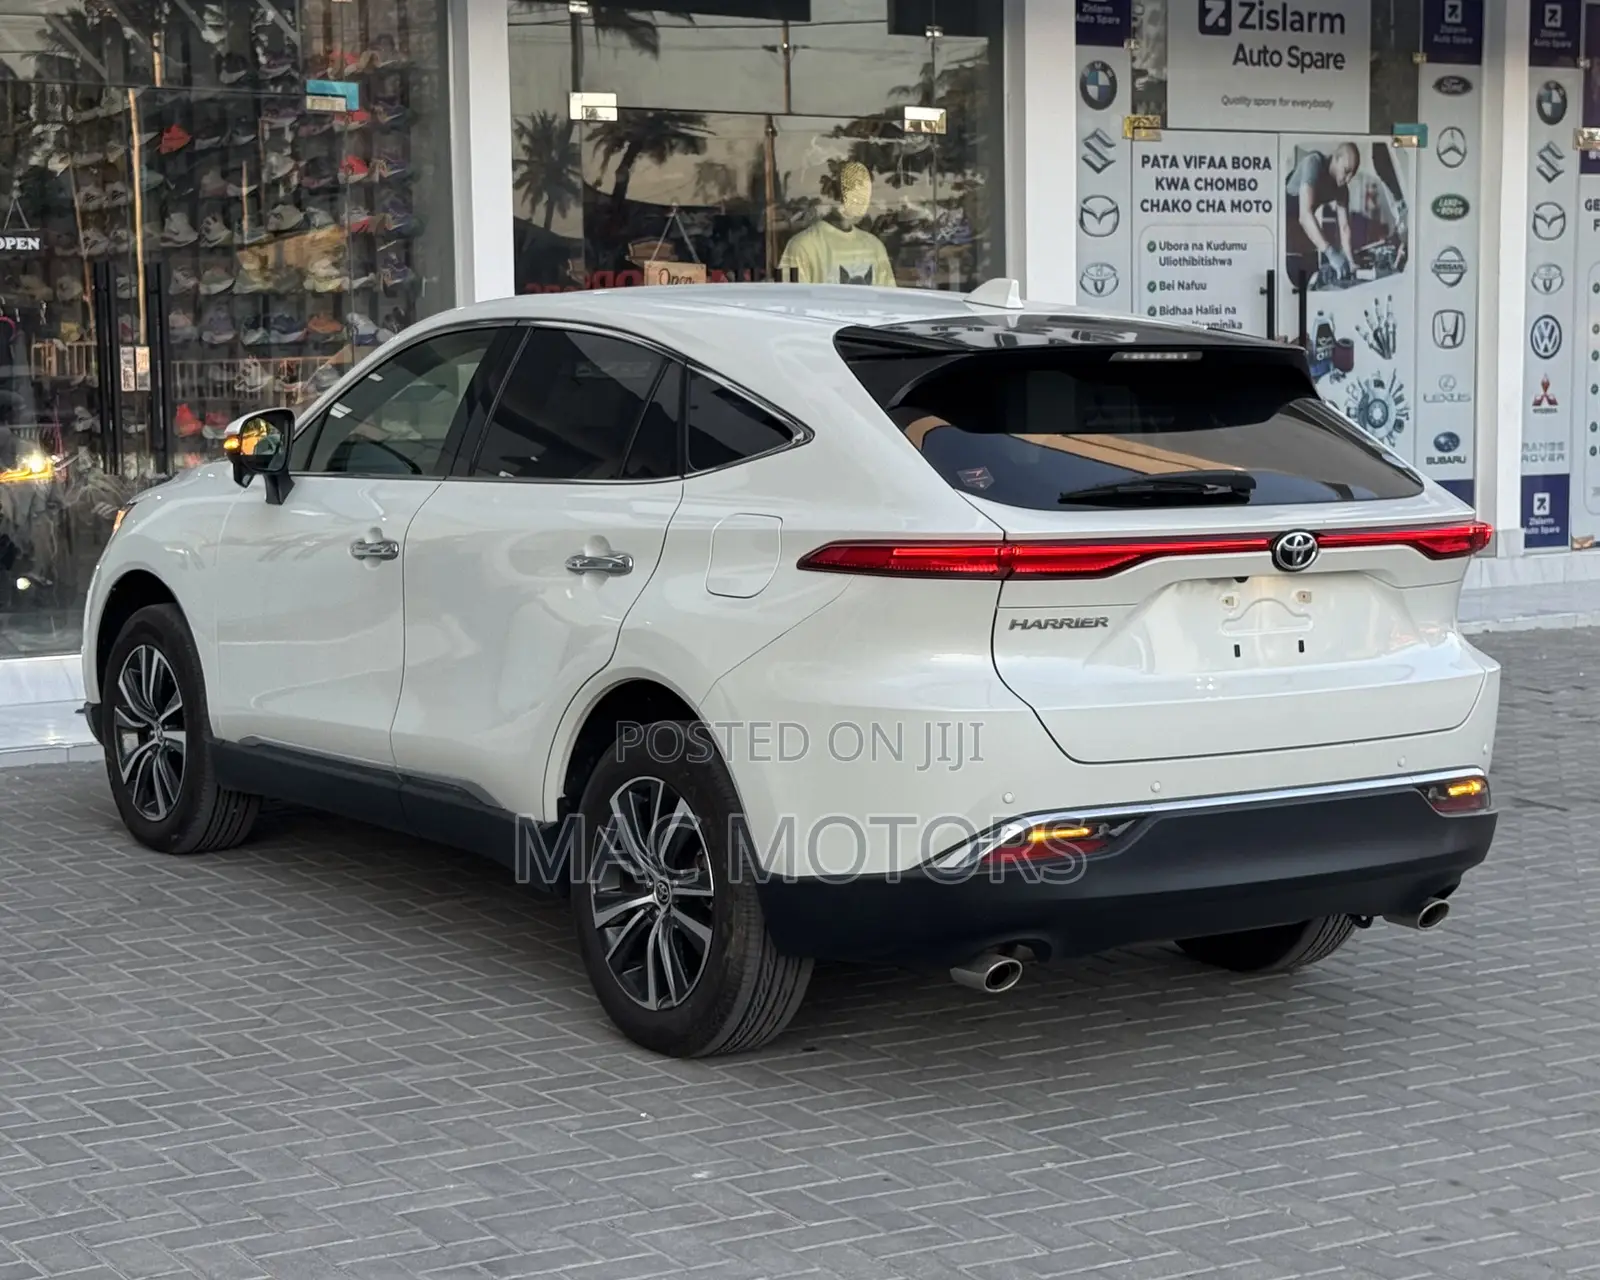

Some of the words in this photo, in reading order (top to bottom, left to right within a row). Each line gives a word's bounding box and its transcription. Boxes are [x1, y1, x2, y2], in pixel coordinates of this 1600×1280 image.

[1238, 0, 1346, 35] Zislarm
[1232, 42, 1283, 68] Auto
[1287, 45, 1346, 74] Spare
[1141, 154, 1179, 169] PATA
[1183, 155, 1228, 170] VIFAA
[1231, 156, 1272, 171] BORA
[1155, 177, 1190, 191] KWA
[1194, 178, 1258, 191] CHOMBO
[1140, 199, 1192, 213] CHAKO
[1196, 199, 1227, 213] CHA
[1230, 200, 1273, 213] MOTO
[1159, 241, 1189, 251] Ubora
[1192, 243, 1204, 251] na
[1159, 257, 1233, 267] Uliothibitishwa
[1159, 280, 1175, 291] Bei
[1177, 280, 1207, 291] Nafuu
[1159, 305, 1193, 316] Bidhaa
[1195, 305, 1222, 315] Halisi
[1224, 307, 1237, 315] na
[1426, 456, 1467, 465] SUBARU
[1008, 616, 1109, 631] HARRIER
